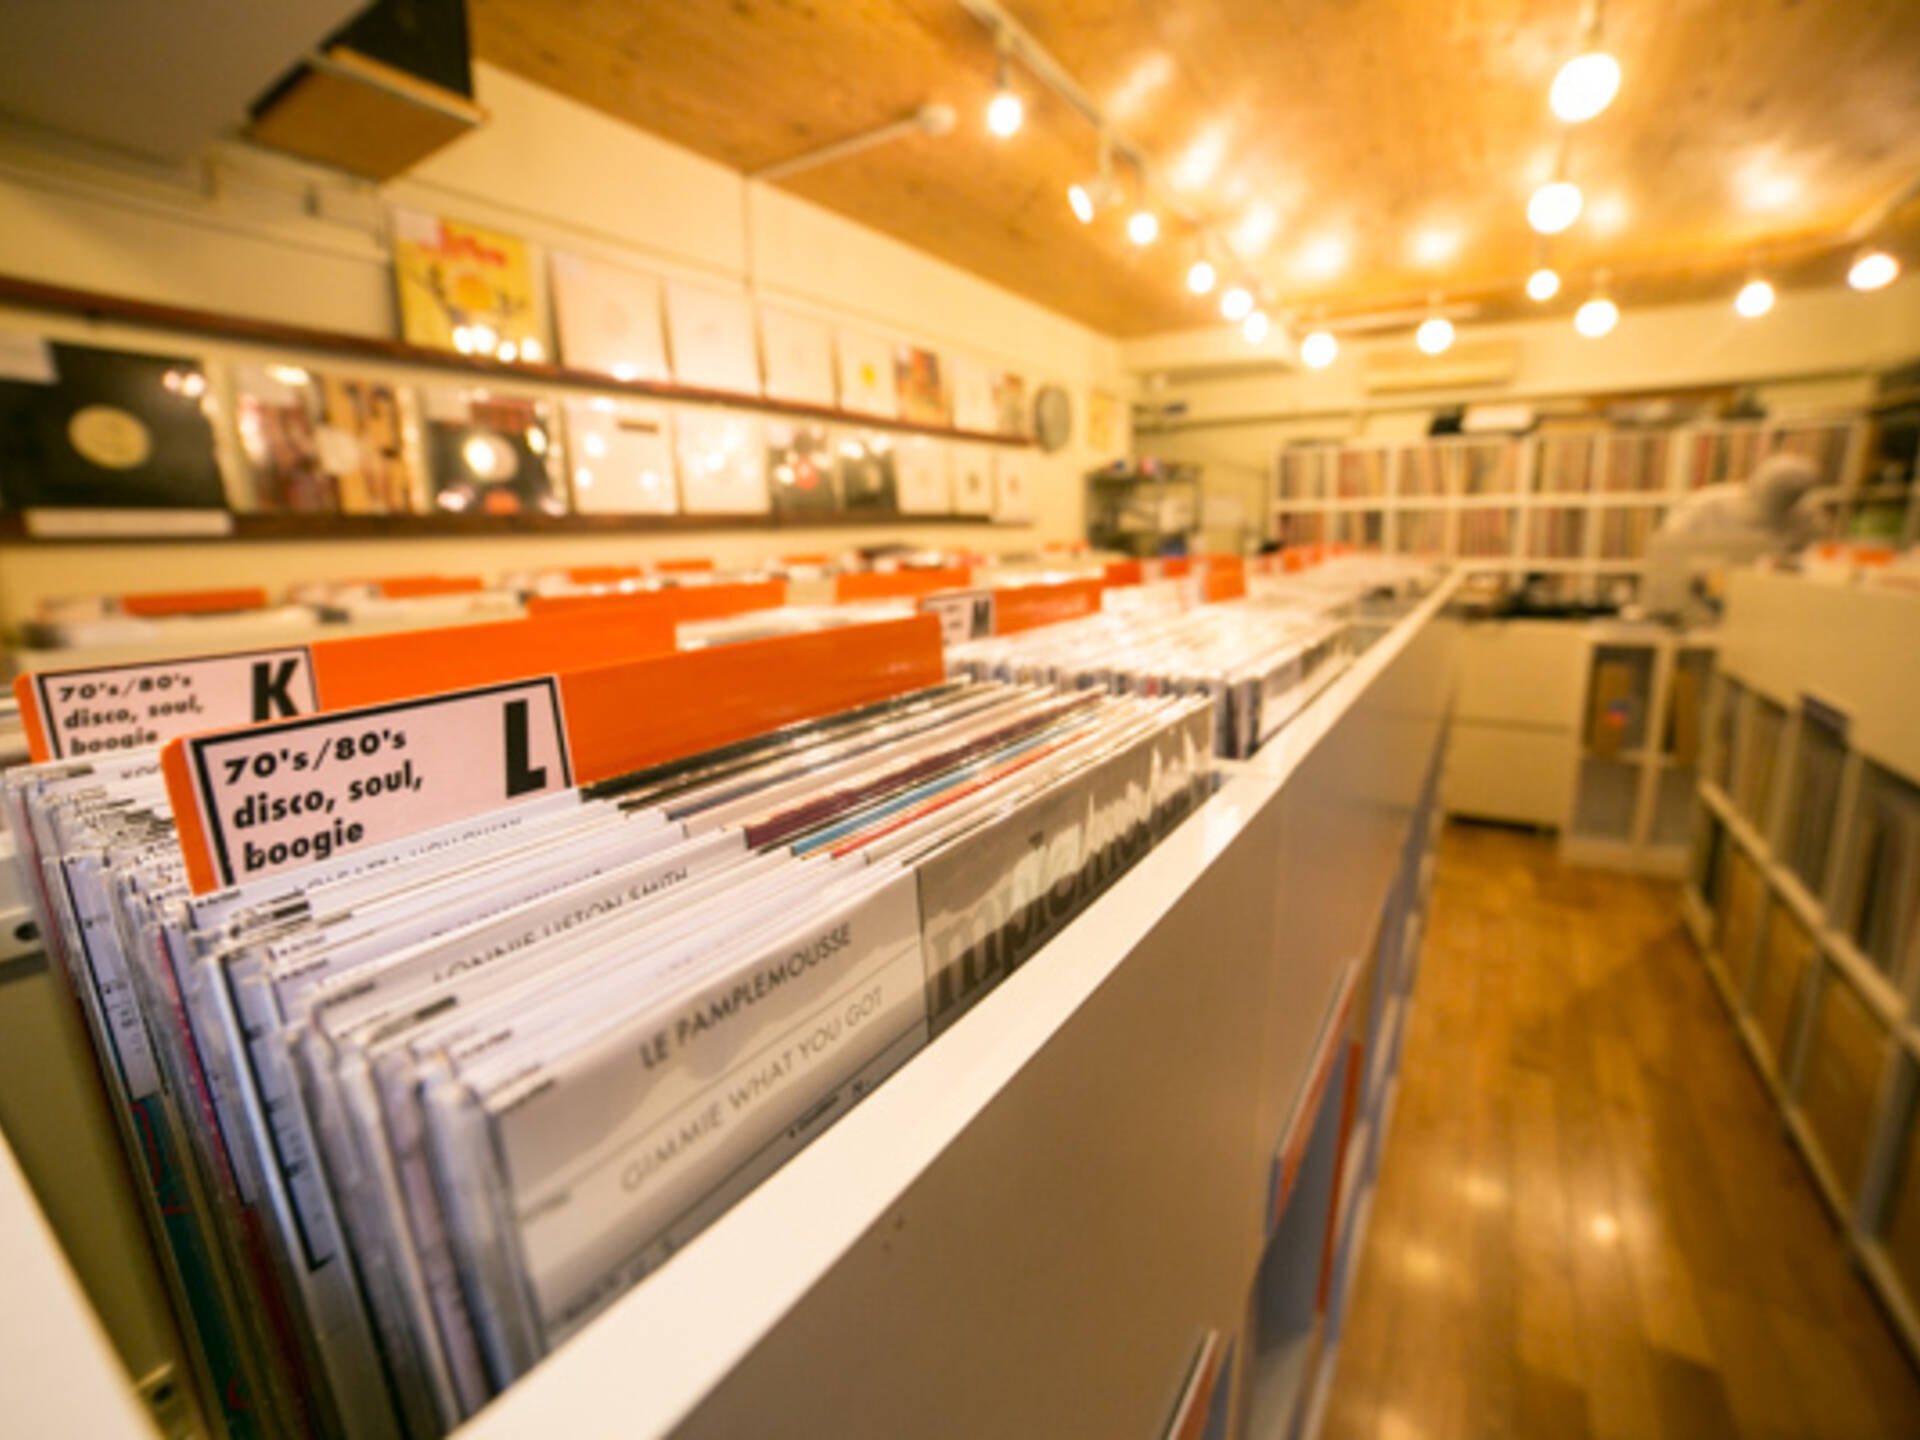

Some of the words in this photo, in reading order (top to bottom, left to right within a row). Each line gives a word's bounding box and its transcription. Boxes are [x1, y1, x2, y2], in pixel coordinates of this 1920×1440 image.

[58, 674, 192, 702] 70's/80's
[64, 708, 137, 729] disco,
[149, 695, 203, 718] soul,
[252, 659, 299, 723] K
[70, 729, 158, 755] boogie
[224, 730, 407, 786] 70's/80's
[504, 699, 547, 798] L
[233, 793, 335, 829] disco,
[348, 759, 423, 802] soul,
[244, 818, 364, 872] boogie
[640, 1029, 668, 1070] LE
[675, 921, 855, 1046] PAMPLEMOUSSE
[621, 1103, 722, 1193] GIMMIE
[729, 1051, 794, 1111] WHAT
[799, 1018, 843, 1061] YOU
[846, 985, 883, 1028] GOT
